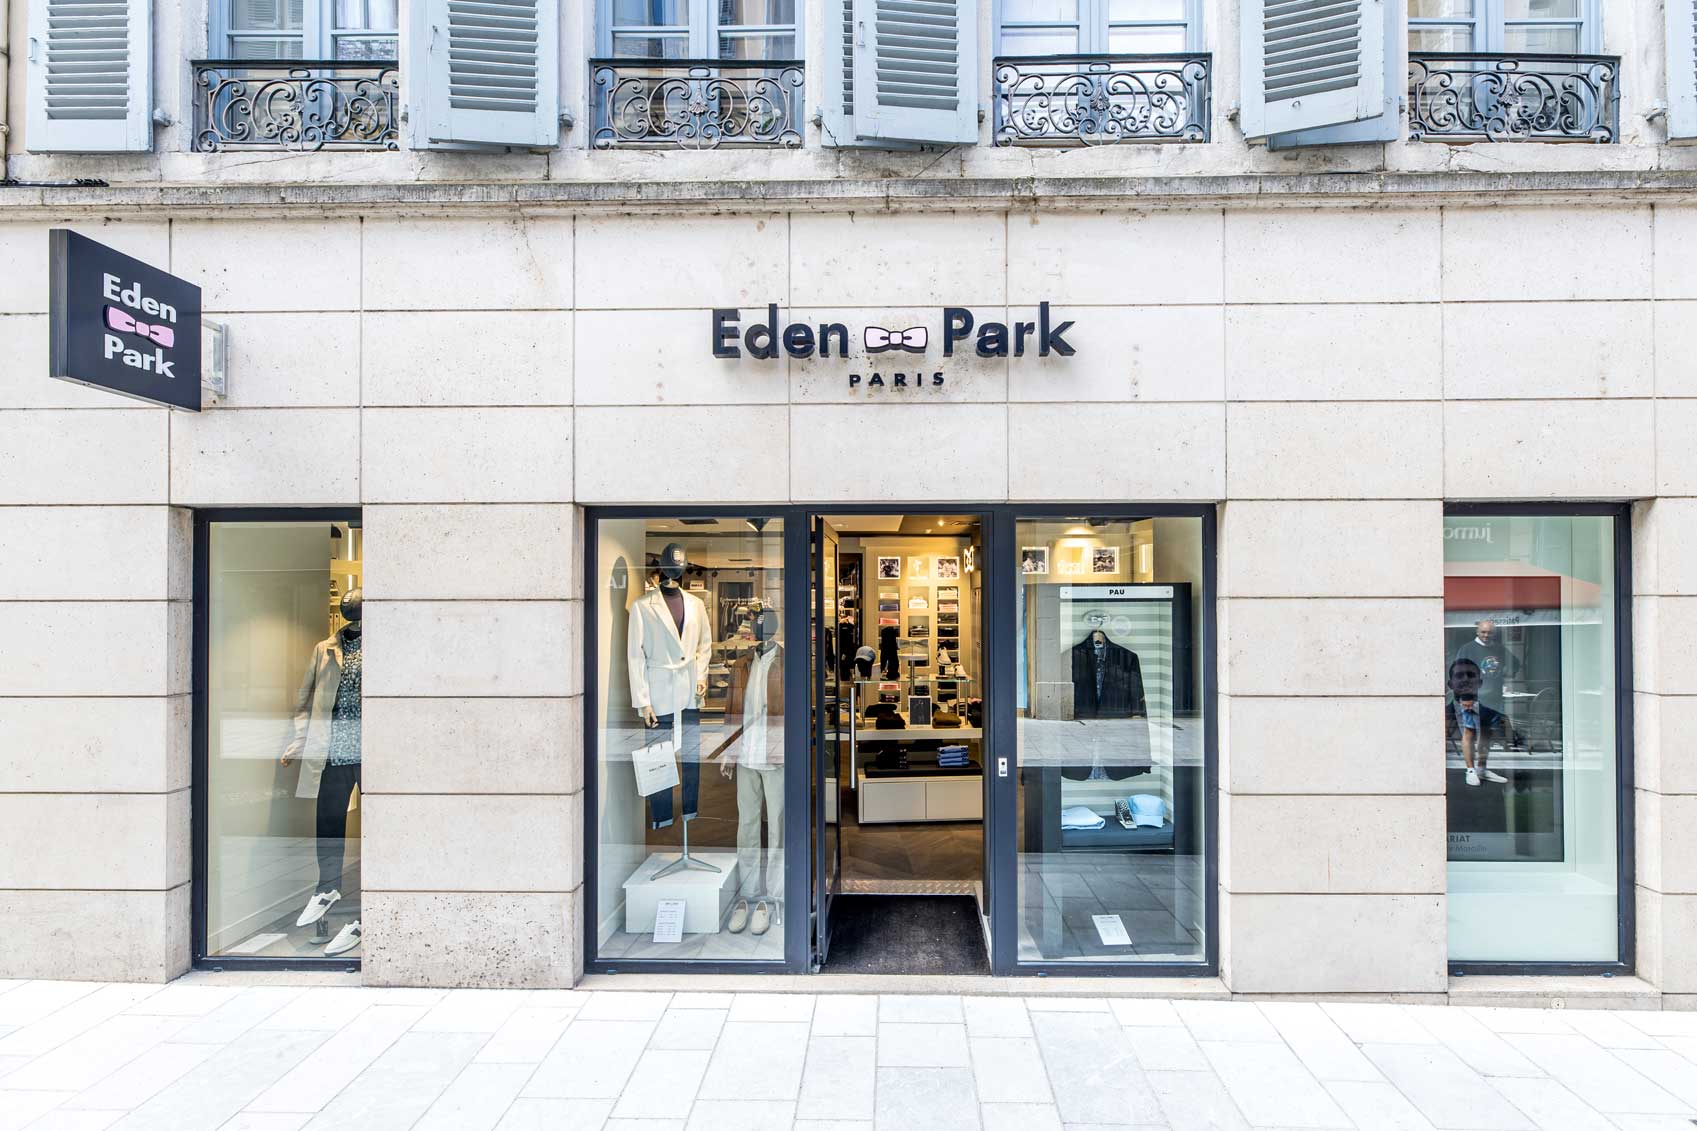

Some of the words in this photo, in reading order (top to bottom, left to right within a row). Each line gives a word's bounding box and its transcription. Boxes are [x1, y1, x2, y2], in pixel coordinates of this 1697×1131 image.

[103, 273, 177, 323] Eden
[712, 302, 850, 360] Eden
[943, 301, 1076, 358] Park
[104, 333, 176, 378] Park
[848, 372, 945, 388] PARIS
[1109, 588, 1125, 596] PAU
